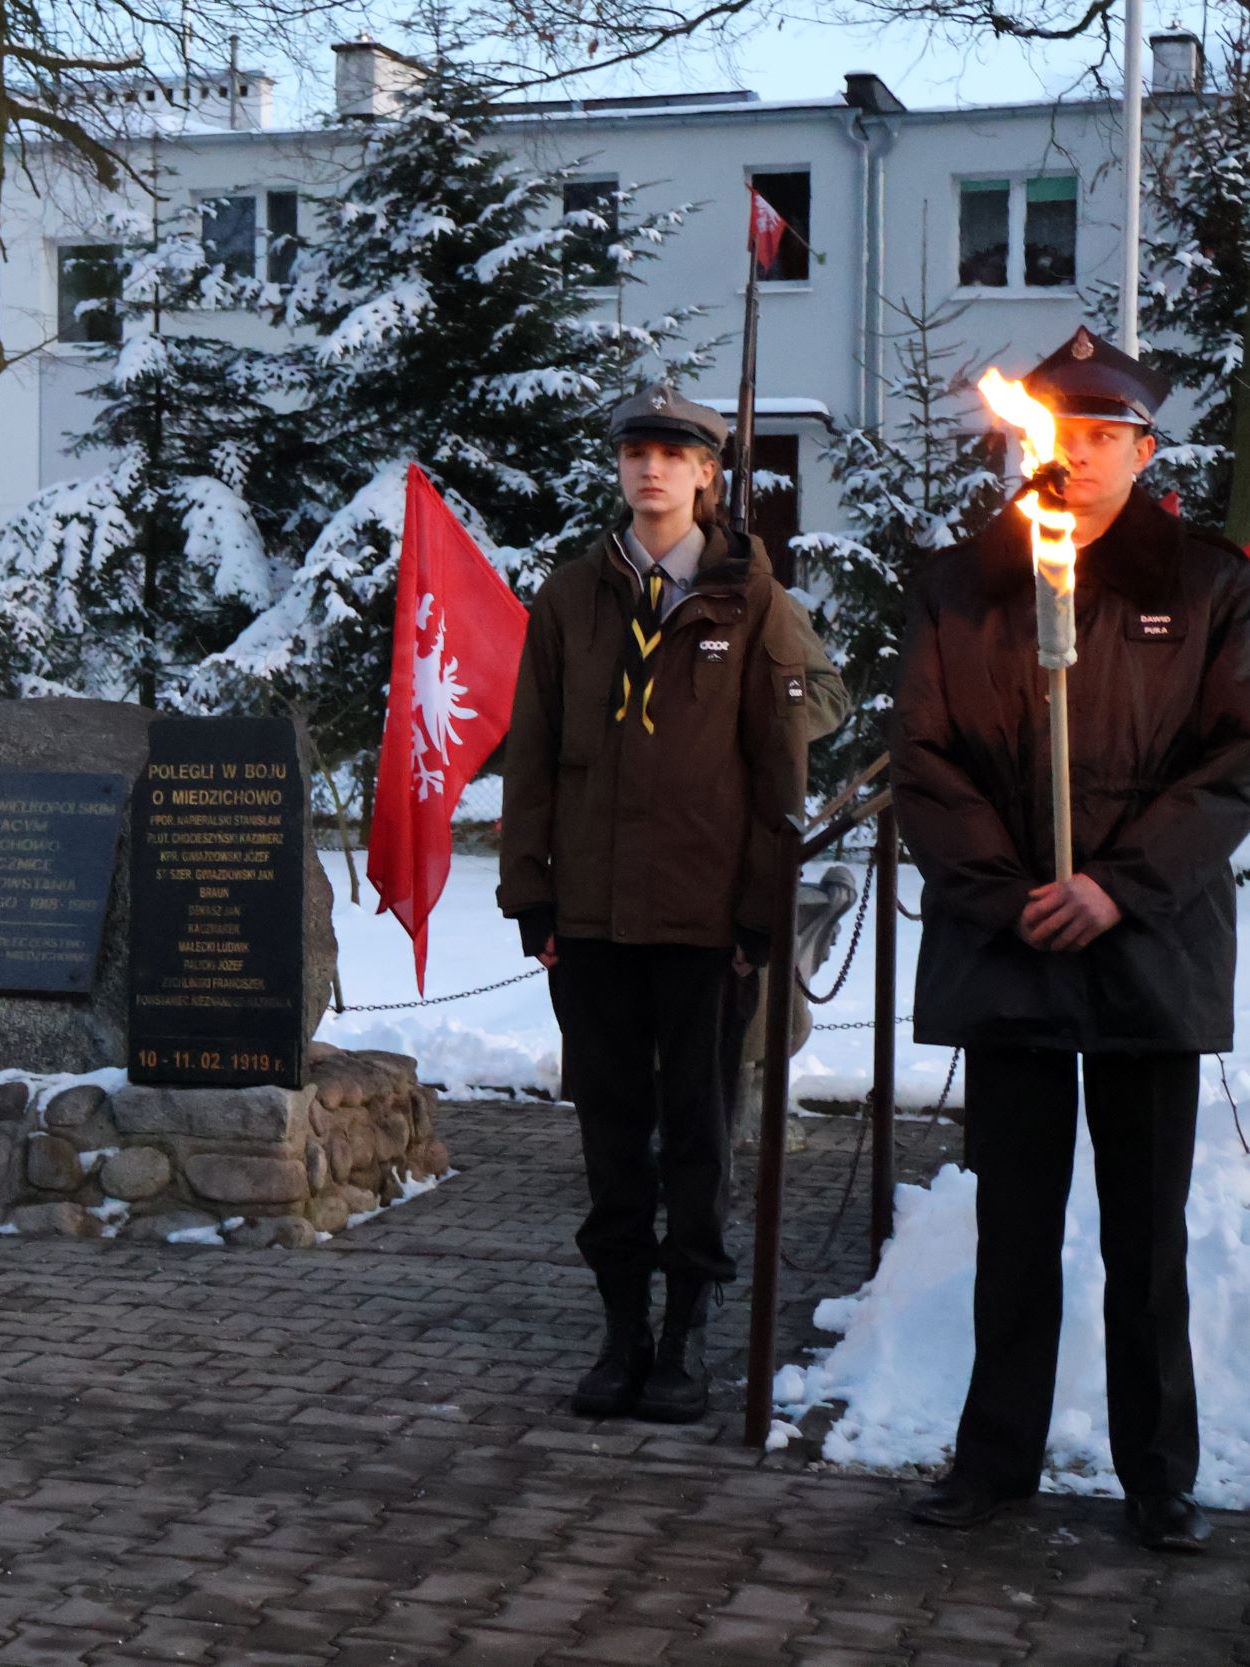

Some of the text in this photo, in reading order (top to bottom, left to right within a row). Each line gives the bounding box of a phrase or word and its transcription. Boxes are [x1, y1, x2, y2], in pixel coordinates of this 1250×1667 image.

[1140, 615, 1171, 623] DAWID
[148, 763, 287, 780] POLEGLI W BOJU
[152, 789, 282, 805] O MIEDZICHOWO
[200, 887, 230, 899] BRAUN
[139, 1050, 158, 1068] 10
[231, 1053, 270, 1071] 1919
